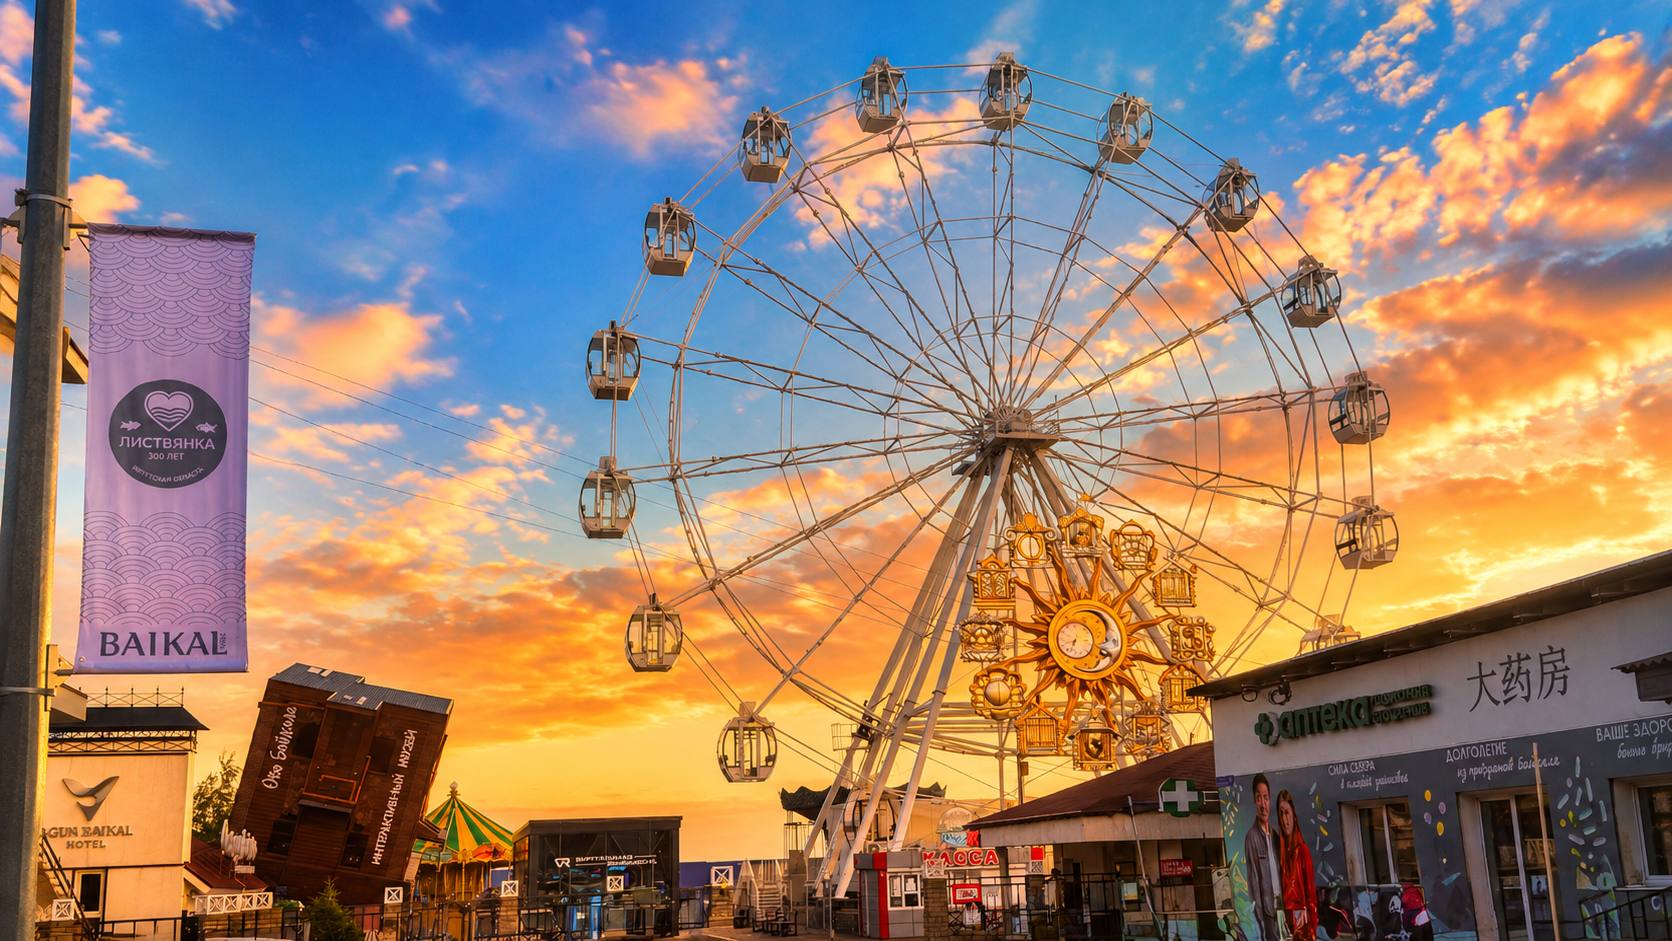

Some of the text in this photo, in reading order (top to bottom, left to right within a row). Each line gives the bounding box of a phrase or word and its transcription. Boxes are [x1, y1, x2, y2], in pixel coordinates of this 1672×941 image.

[119, 436, 216, 450] ЛИСТВЯНКА
[148, 452, 185, 461] 300 ЛЕТ
[100, 630, 228, 657] BAIKAL
[1467, 644, 1570, 713] 大药房
[1278, 694, 1374, 740] аптека
[1595, 723, 1631, 743] ВАШЕ
[1445, 741, 1508, 764] ДОЛГОЛЕТИЕ
[1327, 763, 1349, 776] СИЛА
[370, 728, 419, 865] ИНТЕРАКТИВНЫЙ МУЗЕЙ
[45, 824, 134, 839] GUN BAIKAL
[66, 839, 107, 850] HOTEL
